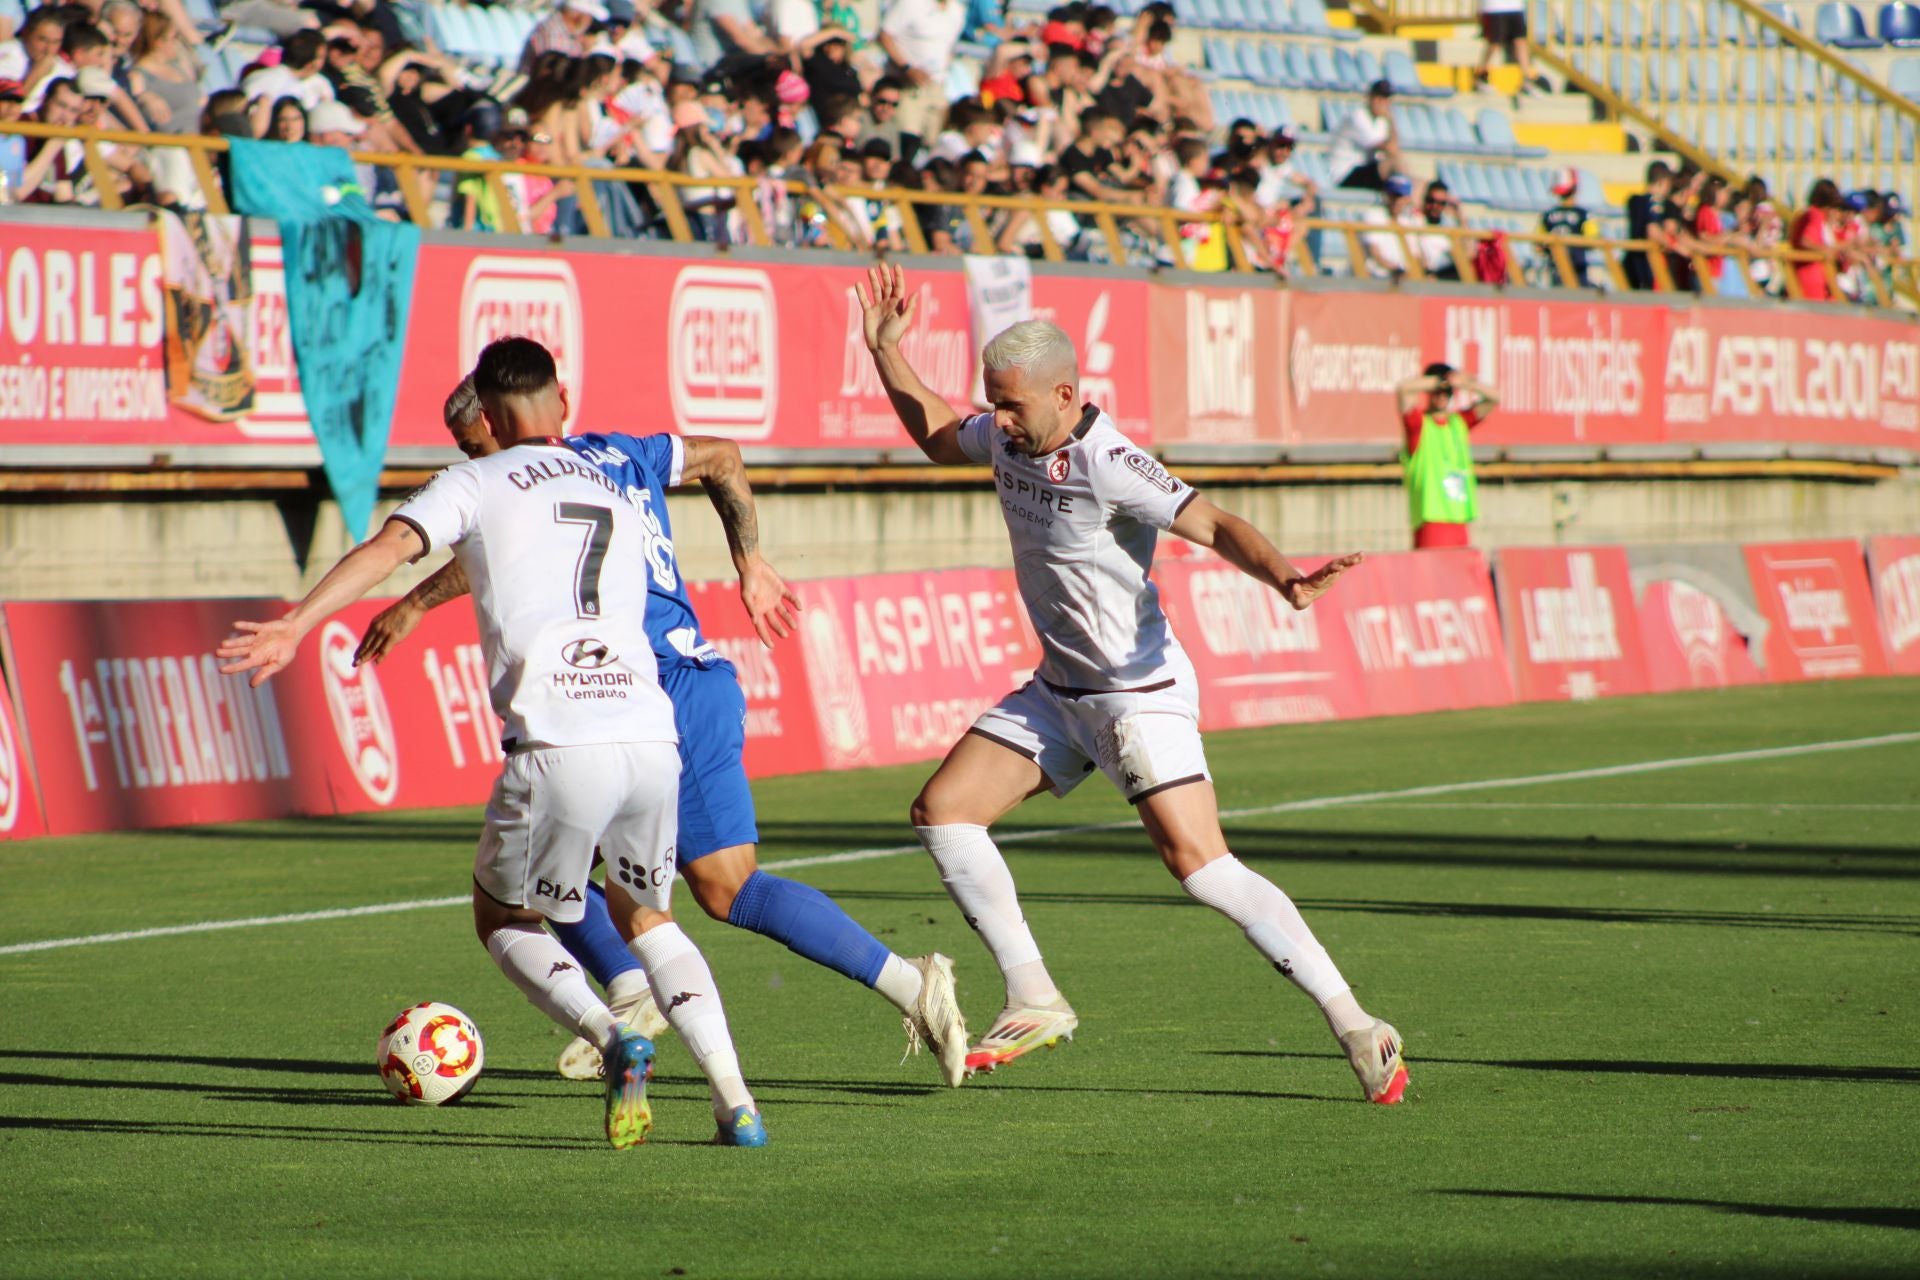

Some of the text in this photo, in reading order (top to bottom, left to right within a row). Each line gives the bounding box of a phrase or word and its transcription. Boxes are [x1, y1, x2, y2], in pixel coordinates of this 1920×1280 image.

[0, 246, 164, 348] ORLES
[994, 464, 1074, 514] ASPIRE
[1000, 496, 1053, 528] ACADEMY
[553, 501, 614, 620] 7
[553, 672, 633, 687] HYUNDAI
[566, 689, 627, 700] Lemauto
